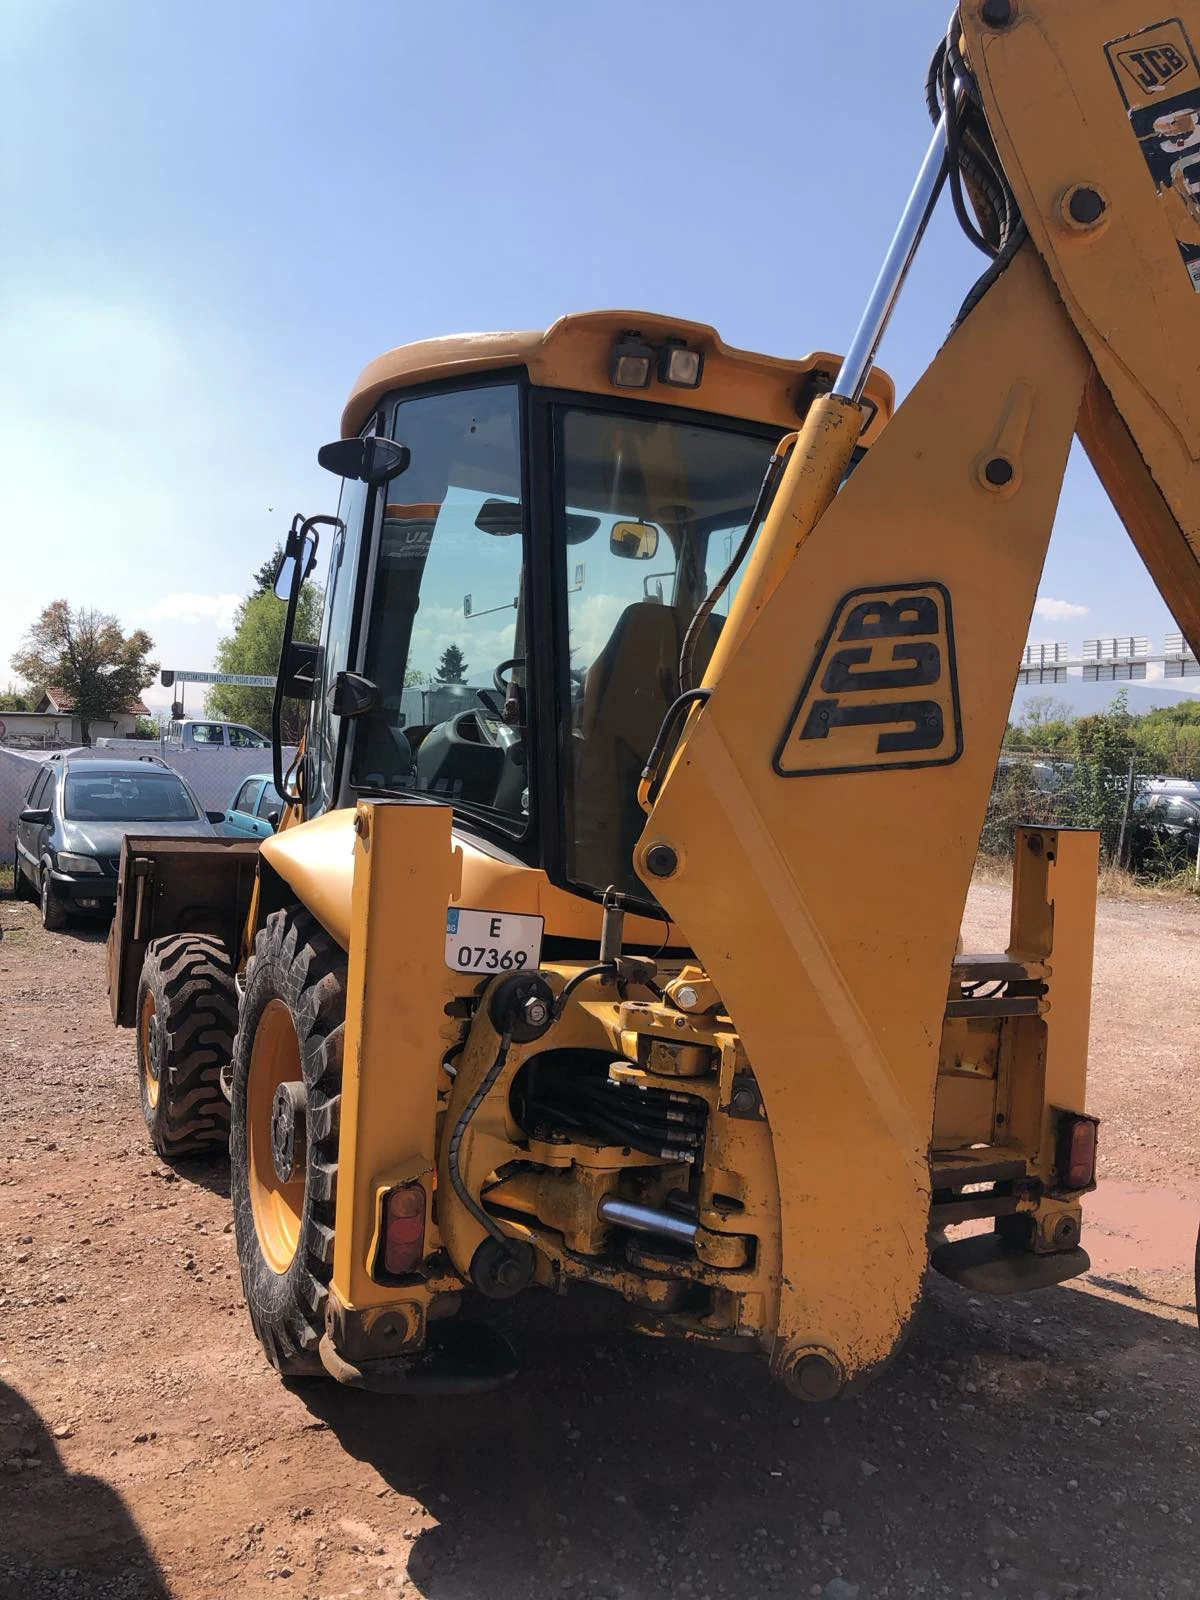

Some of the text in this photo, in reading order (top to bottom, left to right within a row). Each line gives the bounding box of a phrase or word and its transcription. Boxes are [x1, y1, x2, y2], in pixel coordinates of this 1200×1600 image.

[1128, 46, 1184, 88] JCB
[798, 595, 945, 755] JCB
[446, 924, 456, 932] BG
[489, 917, 503, 938] E
[457, 945, 528, 970] 07369
